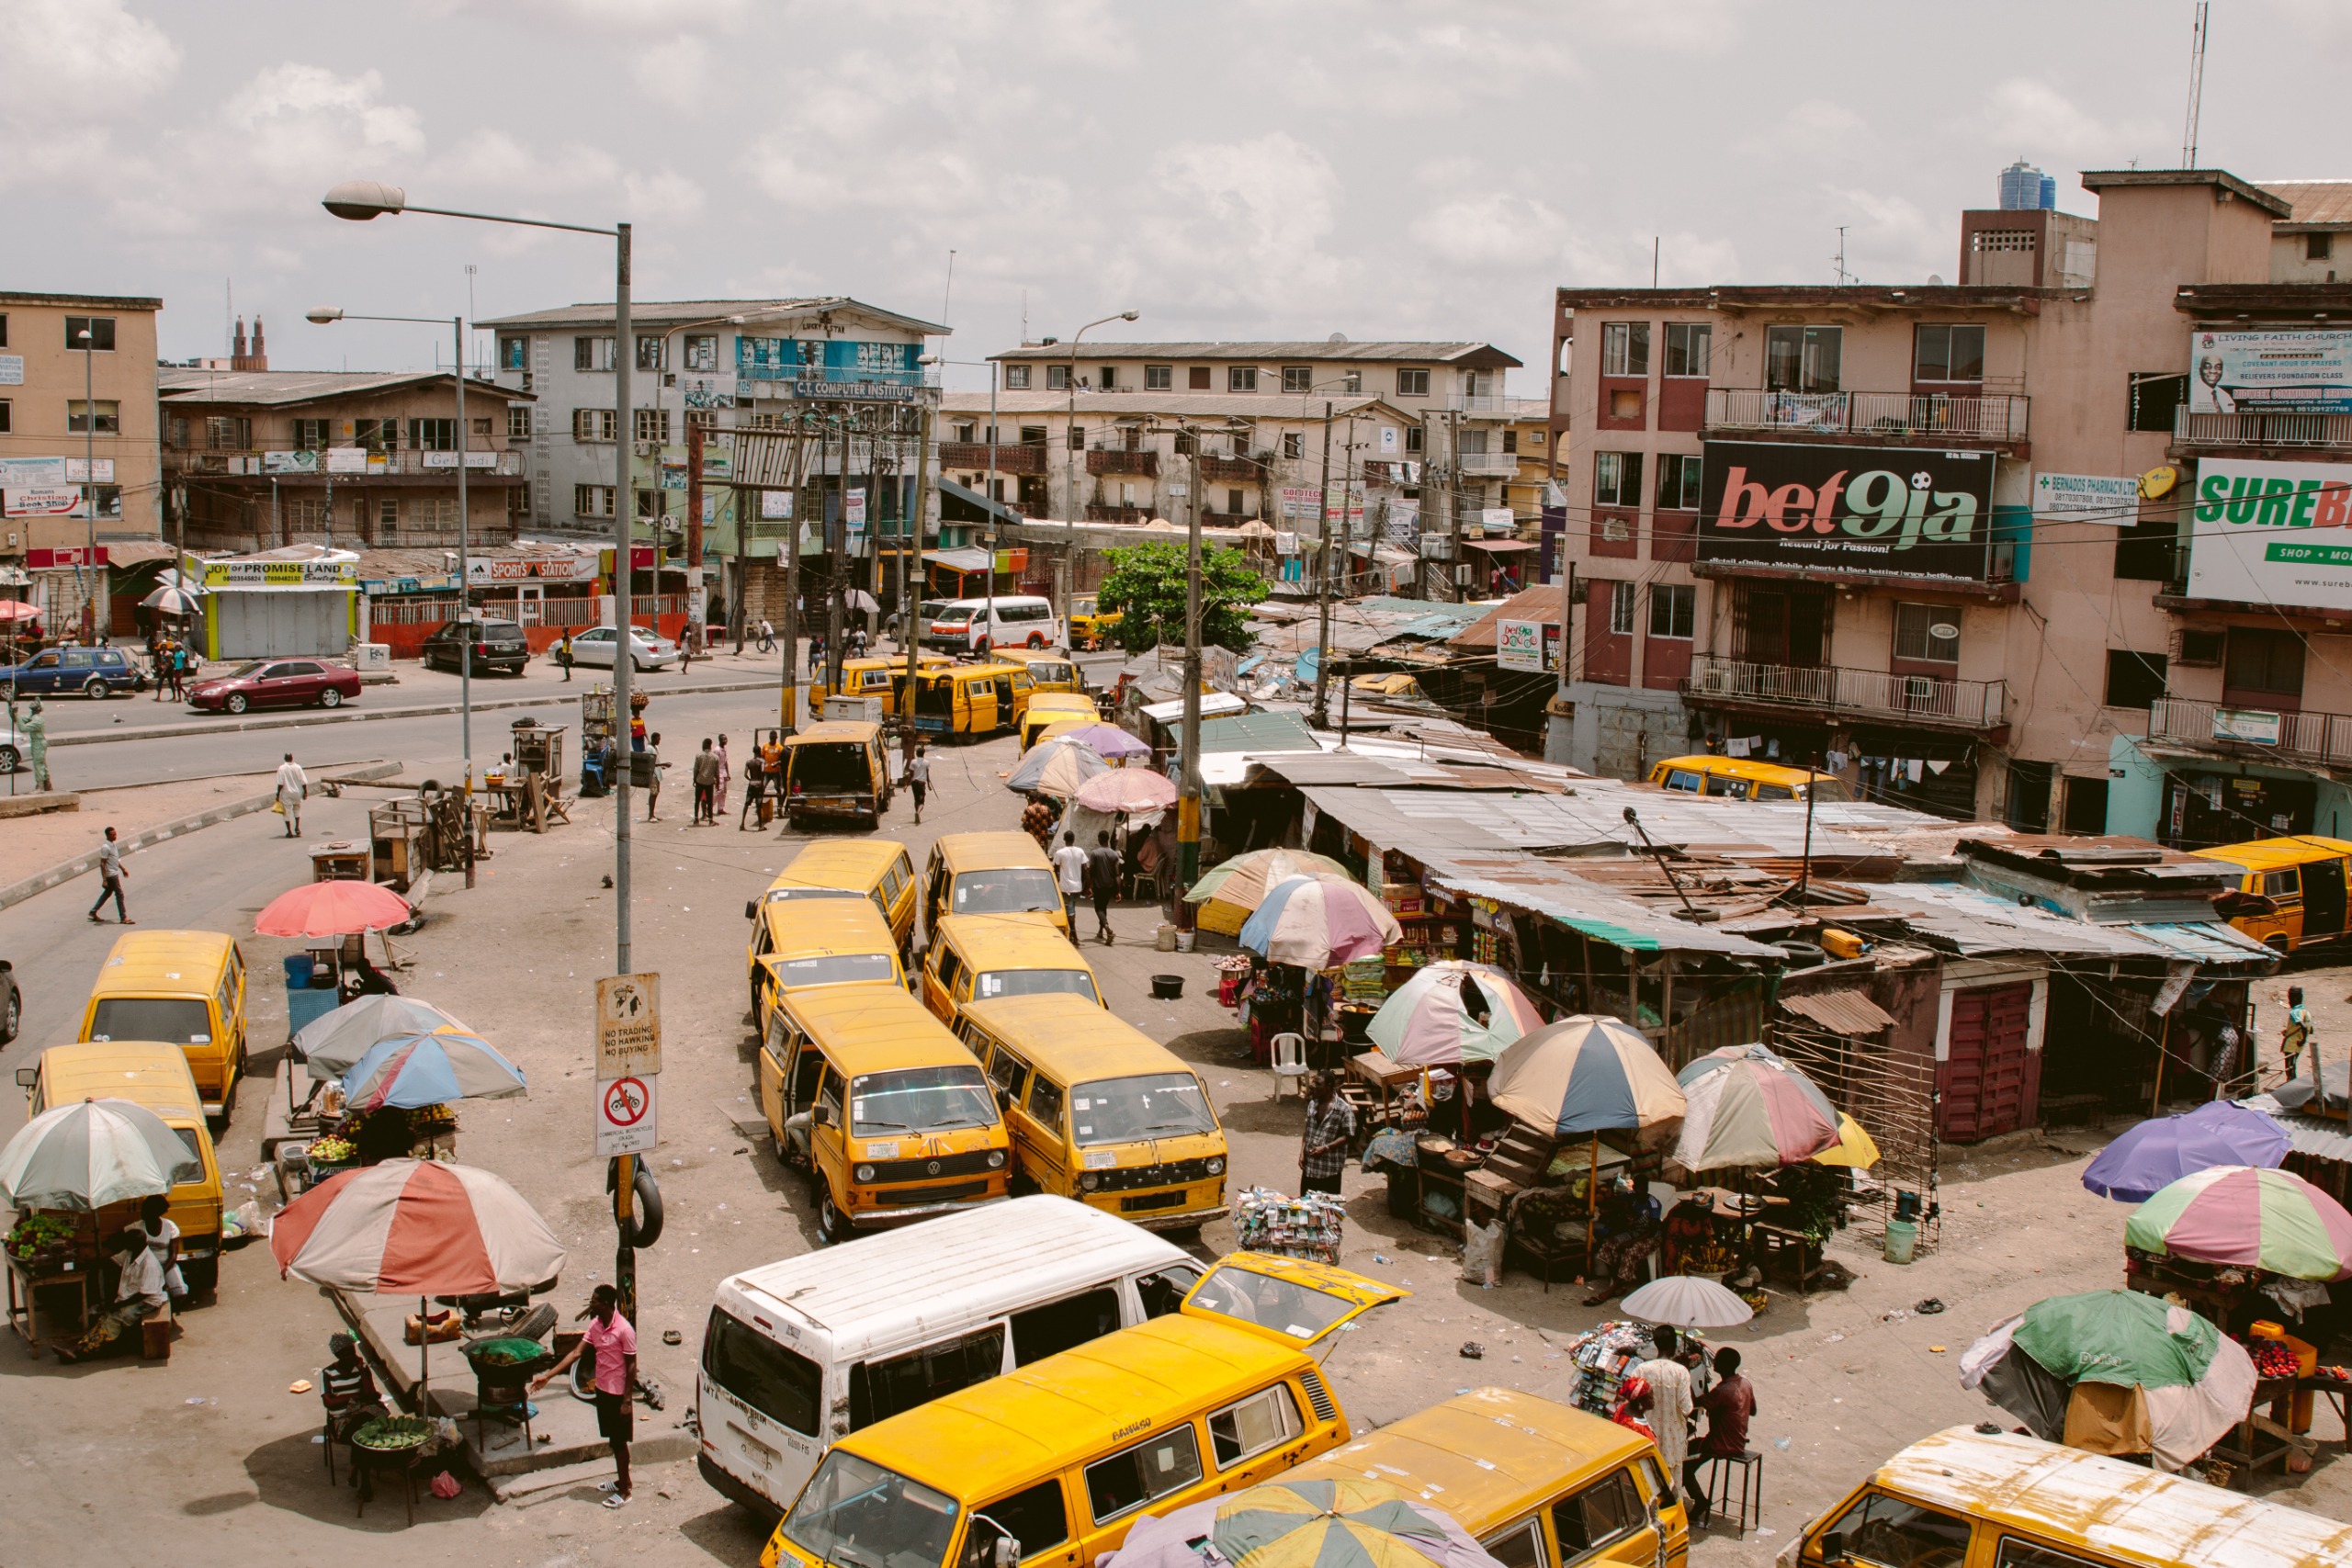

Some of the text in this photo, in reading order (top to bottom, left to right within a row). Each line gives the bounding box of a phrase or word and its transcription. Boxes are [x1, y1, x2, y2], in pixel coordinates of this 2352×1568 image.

[802, 322, 845, 333] LUCKY STAR
[2304, 333, 2352, 341] CHURCH
[738, 380, 752, 392] 105
[797, 382, 914, 397] C.T. COMPUTER INSTITUTE
[2233, 389, 2270, 399] MIDWEEK
[2271, 389, 2323, 399] COMMUNION
[2052, 476, 2086, 493] BERNADOS
[2086, 479, 2122, 495] PHARMACY
[46, 500, 68, 508] Shop
[1714, 466, 1978, 551] bet9ja
[2195, 474, 2352, 530] SUREB
[1780, 537, 1891, 554] Reward for Passion!
[2279, 547, 2352, 560] SHOP MO
[208, 564, 230, 573] JOY
[243, 564, 305, 573] PROMISE
[307, 564, 341, 573] LAND
[492, 561, 574, 578] SPORTS STATION
[1742, 558, 1770, 567] Online
[1808, 563, 1836, 571] Sports
[1868, 567, 1899, 576] betting
[1504, 624, 1532, 637] bet9ja
[605, 1025, 652, 1038] NO TRADING
[605, 1034, 655, 1047] NO HAWKING
[605, 1044, 649, 1056] NO BUYING
[599, 1125, 653, 1138] COMMERCIAL MOTORCYCLES
